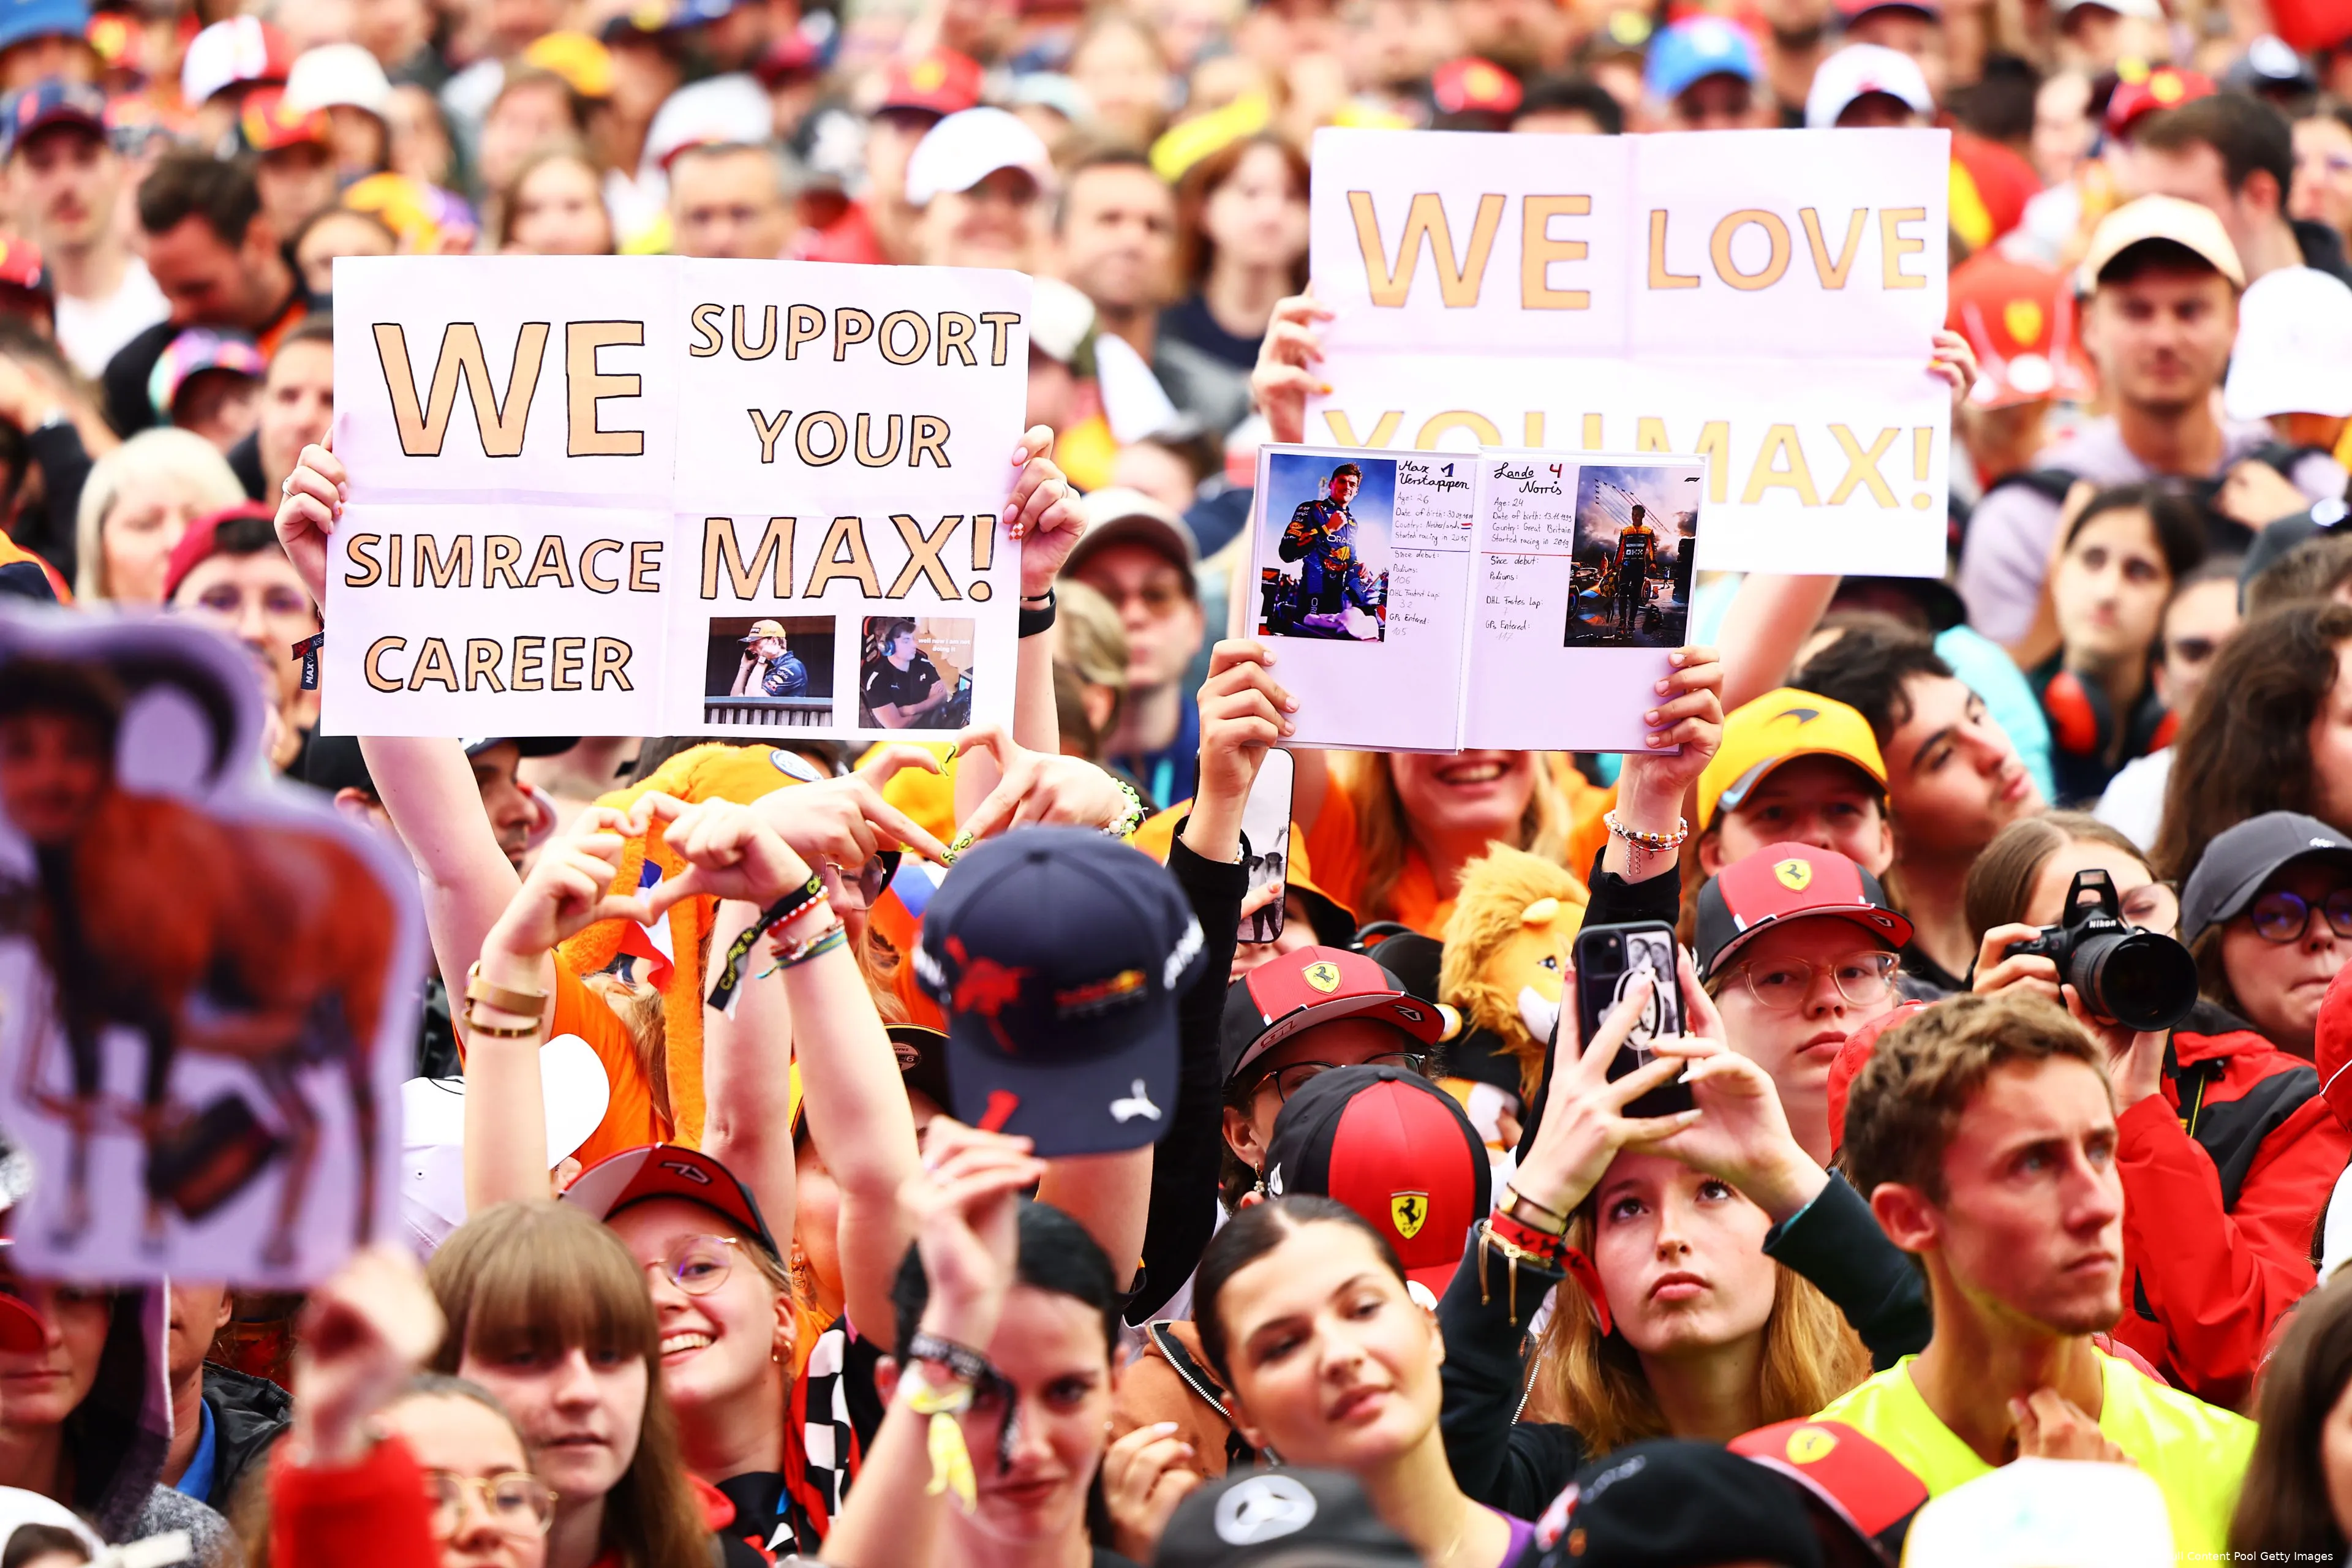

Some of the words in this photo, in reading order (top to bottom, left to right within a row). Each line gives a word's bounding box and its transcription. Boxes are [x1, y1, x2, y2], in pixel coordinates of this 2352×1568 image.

[1347, 190, 1591, 310] WE
[1647, 206, 1927, 291] LOVE
[689, 303, 1021, 366] SUPPORT
[371, 320, 645, 458] WE
[747, 408, 952, 468] YOUR
[1398, 460, 1430, 473] Max
[1441, 462, 1454, 477] 1
[1493, 462, 1534, 480] Lando
[1549, 463, 1562, 478] 4
[1637, 418, 1933, 511] MAX!
[1399, 472, 1469, 492] Verstappen
[1519, 480, 1562, 495] Norris
[1396, 491, 1412, 505] Age:
[1417, 494, 1429, 503] 26
[1493, 497, 1510, 512] Age:
[1512, 498, 1524, 507] 24
[1395, 507, 1411, 516] Date
[1415, 508, 1425, 517] of
[1426, 509, 1446, 518] birth:
[1512, 510, 1521, 519] of
[1523, 511, 1541, 521] birth:
[1395, 520, 1422, 532] Country:
[1426, 521, 1460, 530] Netherlands
[1492, 522, 1519, 535] Country:
[1523, 522, 1541, 531] Great
[1547, 523, 1572, 534] Britain
[1419, 533, 1438, 546] racing
[1451, 533, 1468, 542] 2015
[1491, 533, 1517, 544] Started
[1520, 538, 1540, 550] racing
[1553, 538, 1570, 549] 2019
[700, 514, 997, 602] MAX!
[1395, 550, 1412, 559] Since
[1416, 549, 1439, 559] debut:
[1490, 555, 1509, 565] Since
[1514, 554, 1539, 565] debut:
[345, 532, 663, 594] SIMRACE
[1393, 564, 1418, 573] Podiums:
[1394, 576, 1411, 585] 106
[1490, 570, 1518, 581] Podiums:
[1486, 595, 1501, 605] DHL
[1503, 595, 1526, 606] Fastes
[1529, 597, 1544, 609] Lap:
[1389, 613, 1401, 622] GPs
[1404, 613, 1430, 625] Entered:
[1485, 620, 1497, 630] GPs
[1500, 619, 1531, 630] Entered:
[364, 635, 635, 693] CAREER
[2089, 919, 2117, 929] Nikon
